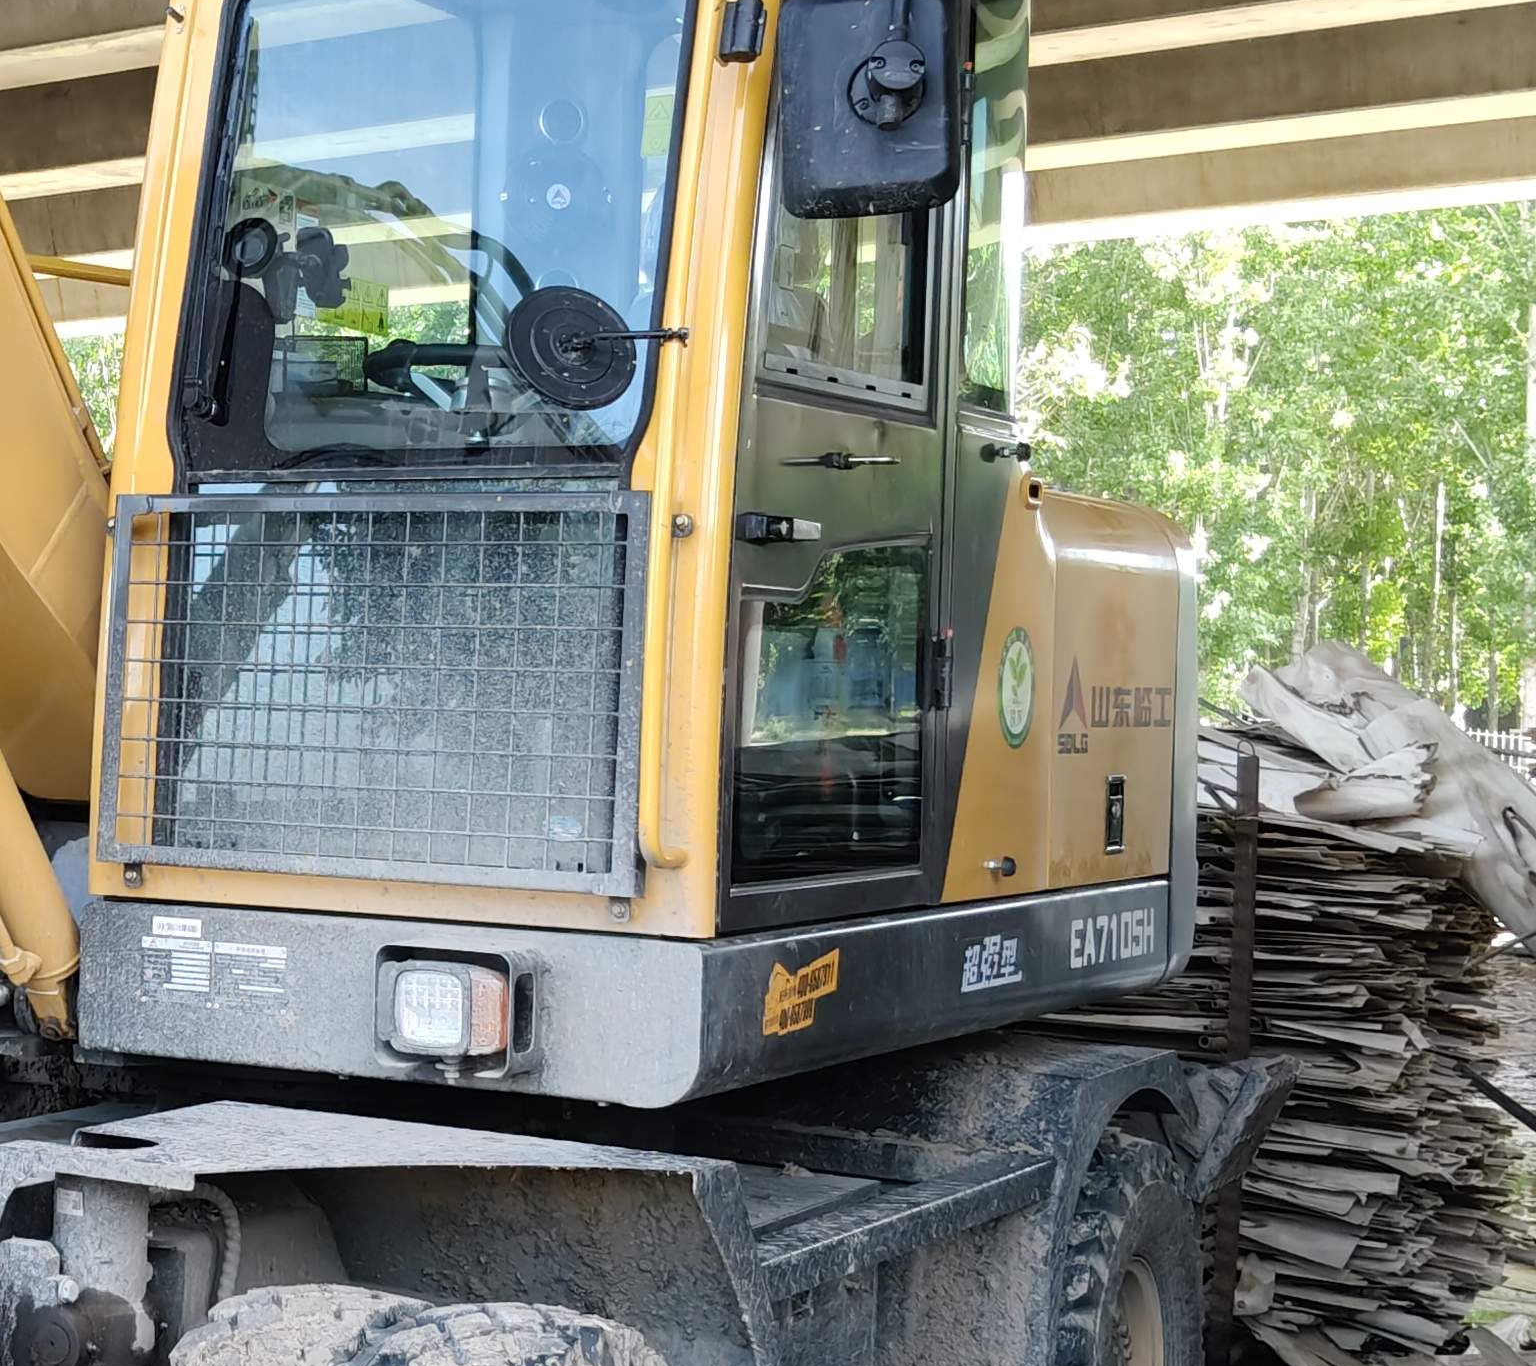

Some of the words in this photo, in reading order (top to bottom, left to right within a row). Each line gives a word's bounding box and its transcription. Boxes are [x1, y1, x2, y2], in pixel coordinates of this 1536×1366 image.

[1091, 685, 1172, 728] 山东临工
[1057, 733, 1089, 754] SDLG
[1070, 907, 1154, 969] EA7105H
